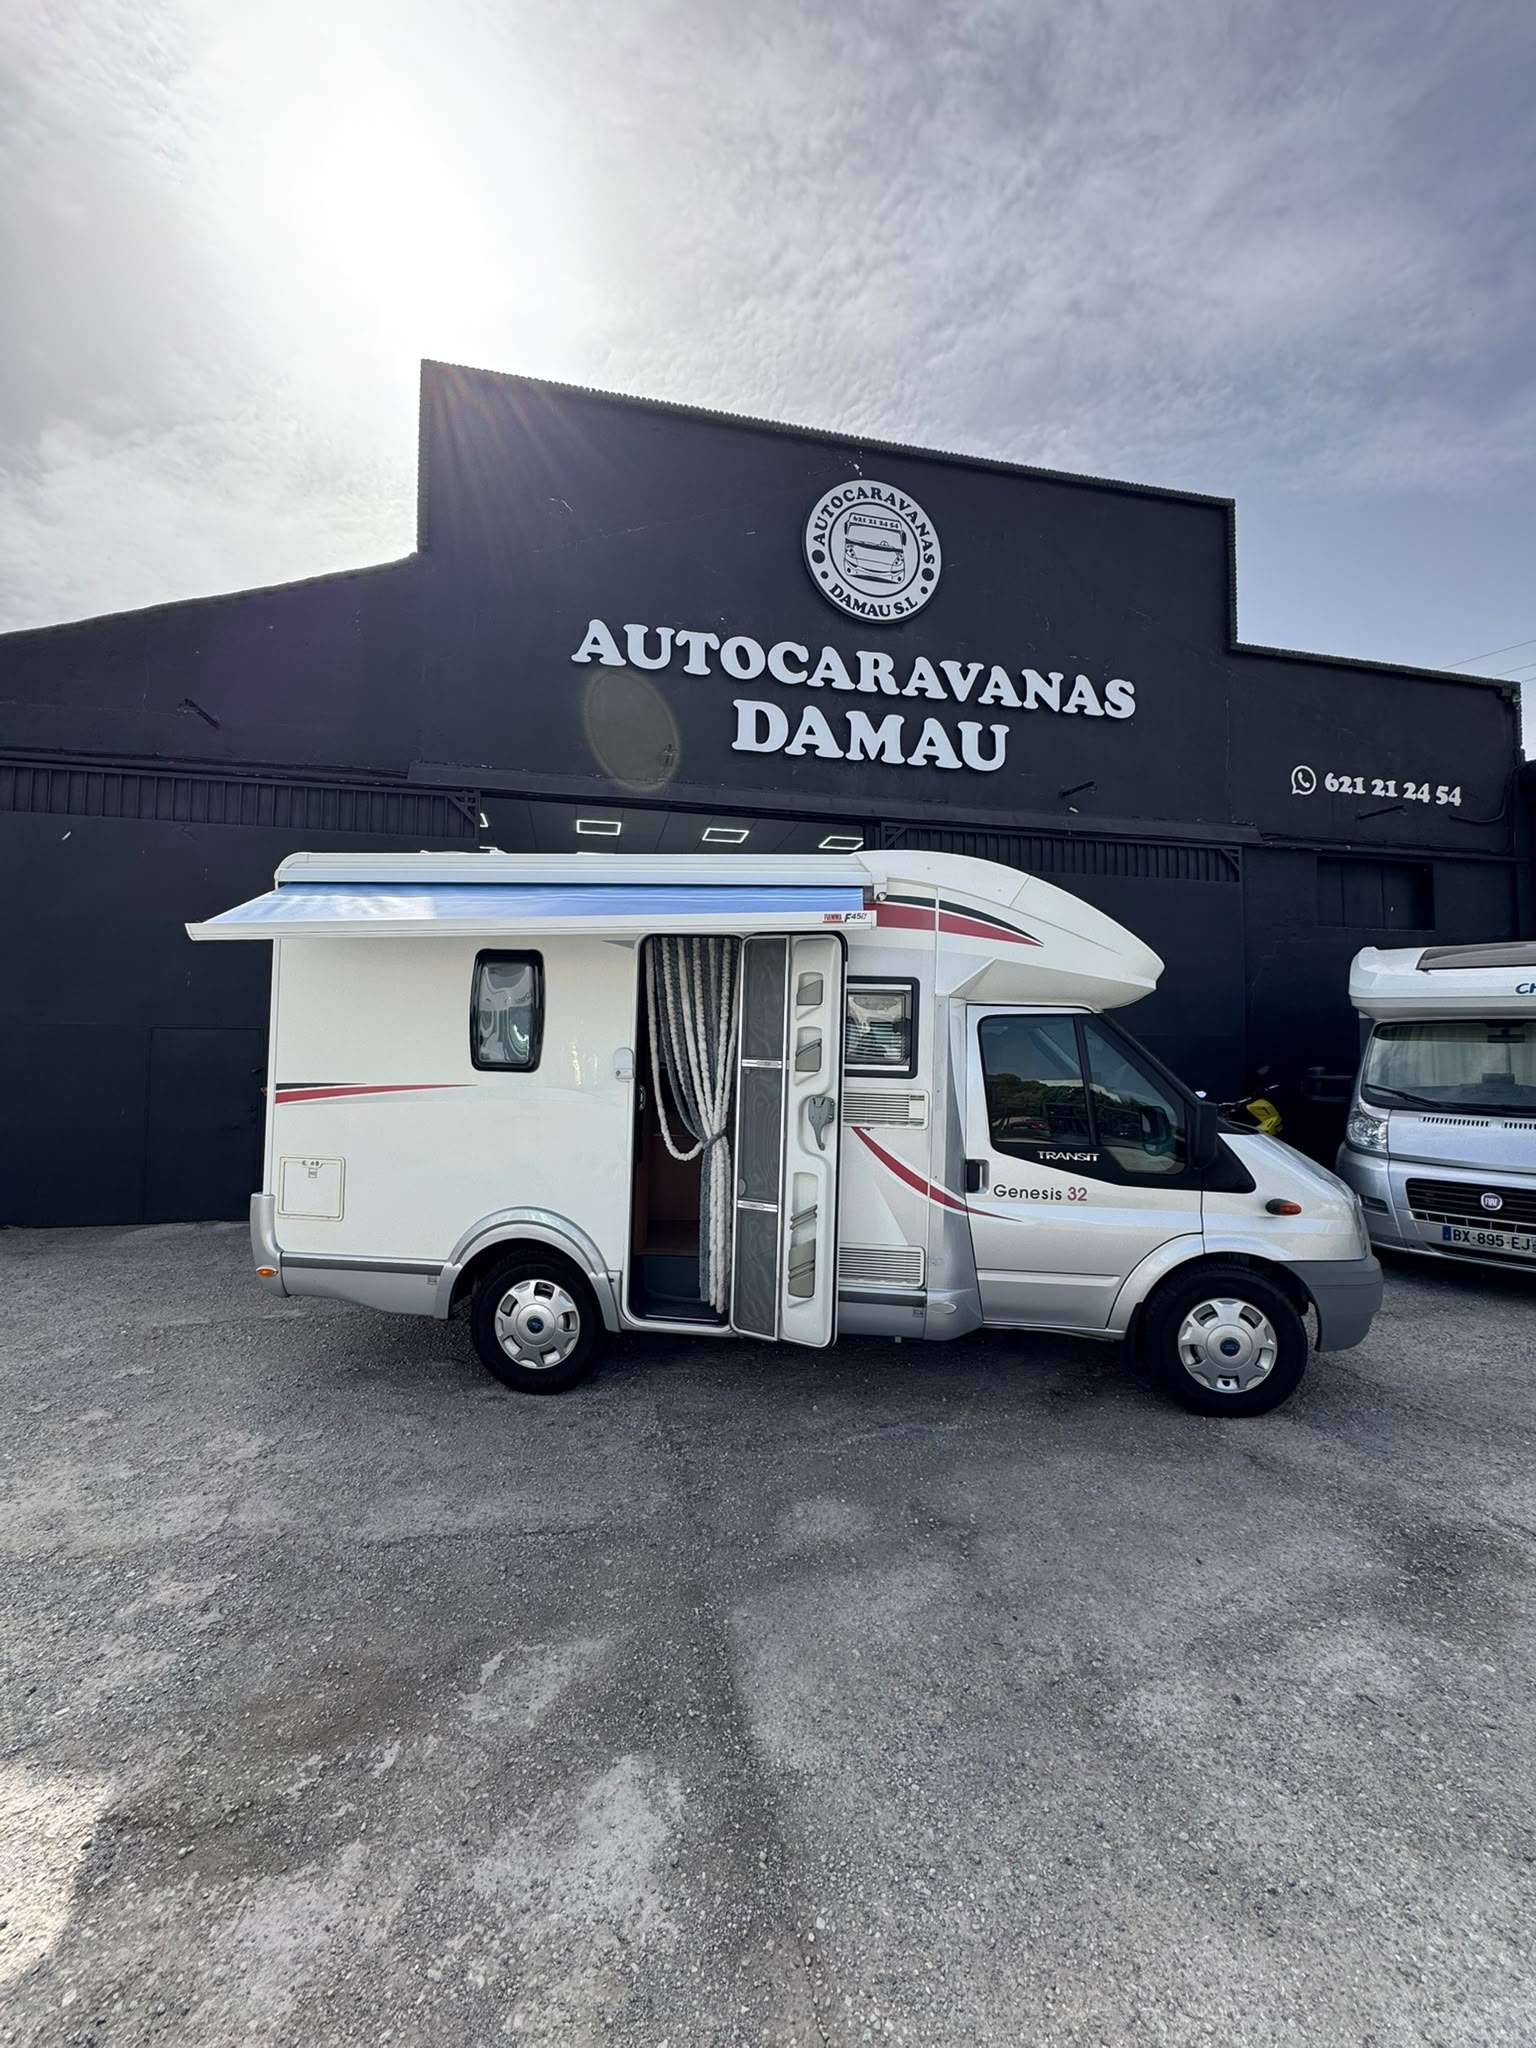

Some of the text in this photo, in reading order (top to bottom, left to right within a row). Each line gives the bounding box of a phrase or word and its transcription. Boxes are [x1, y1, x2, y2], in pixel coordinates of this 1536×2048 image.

[813, 486, 935, 565] AUTOCARAVANAS
[828, 583, 891, 617] DAMAU
[571, 619, 1136, 719] AUTOCARAVANAS
[731, 699, 1010, 772] DAMAU
[1324, 772, 1462, 807] 621 21 24 54
[1037, 1150, 1100, 1162] TRANSIT
[993, 1184, 1088, 1202] Genesis 32
[1453, 1229, 1530, 1250] BX-895-EJ
